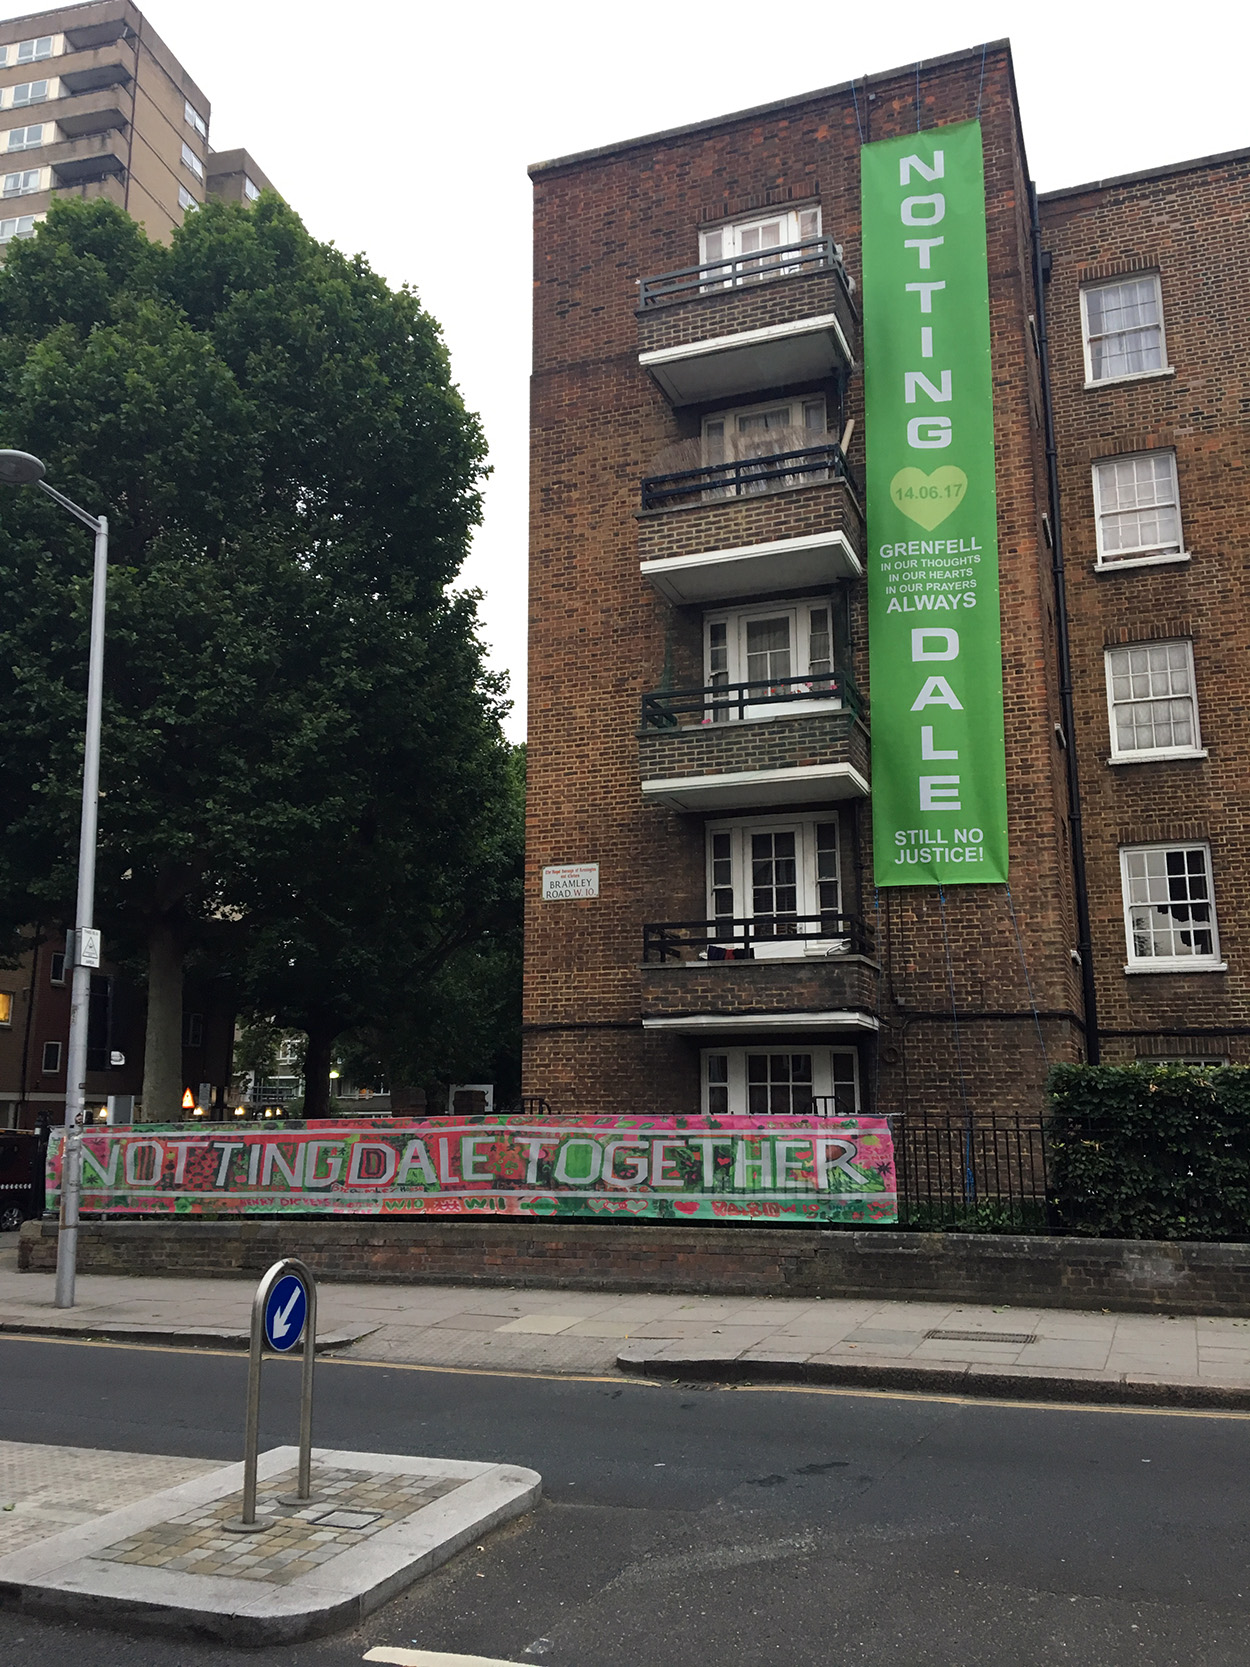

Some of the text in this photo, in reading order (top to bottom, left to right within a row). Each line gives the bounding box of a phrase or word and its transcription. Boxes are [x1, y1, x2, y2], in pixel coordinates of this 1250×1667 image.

[899, 150, 952, 448] NOTTING
[895, 484, 962, 501] 14.06.17
[880, 537, 982, 558] GRENFELL
[881, 555, 981, 571] IN OUR THOUGHTS
[889, 567, 973, 582] IN OUR HEARTS
[886, 579, 977, 594] IN OUR PRAYERS
[886, 592, 977, 613] ALWAYS
[910, 627, 964, 811] DALE
[894, 828, 984, 846] STILL NO
[894, 847, 984, 865] JUSTICE!
[550, 879, 592, 889] BRAMLEY
[81, 1136, 869, 1189] NOTTINGDALE TOGETHER
